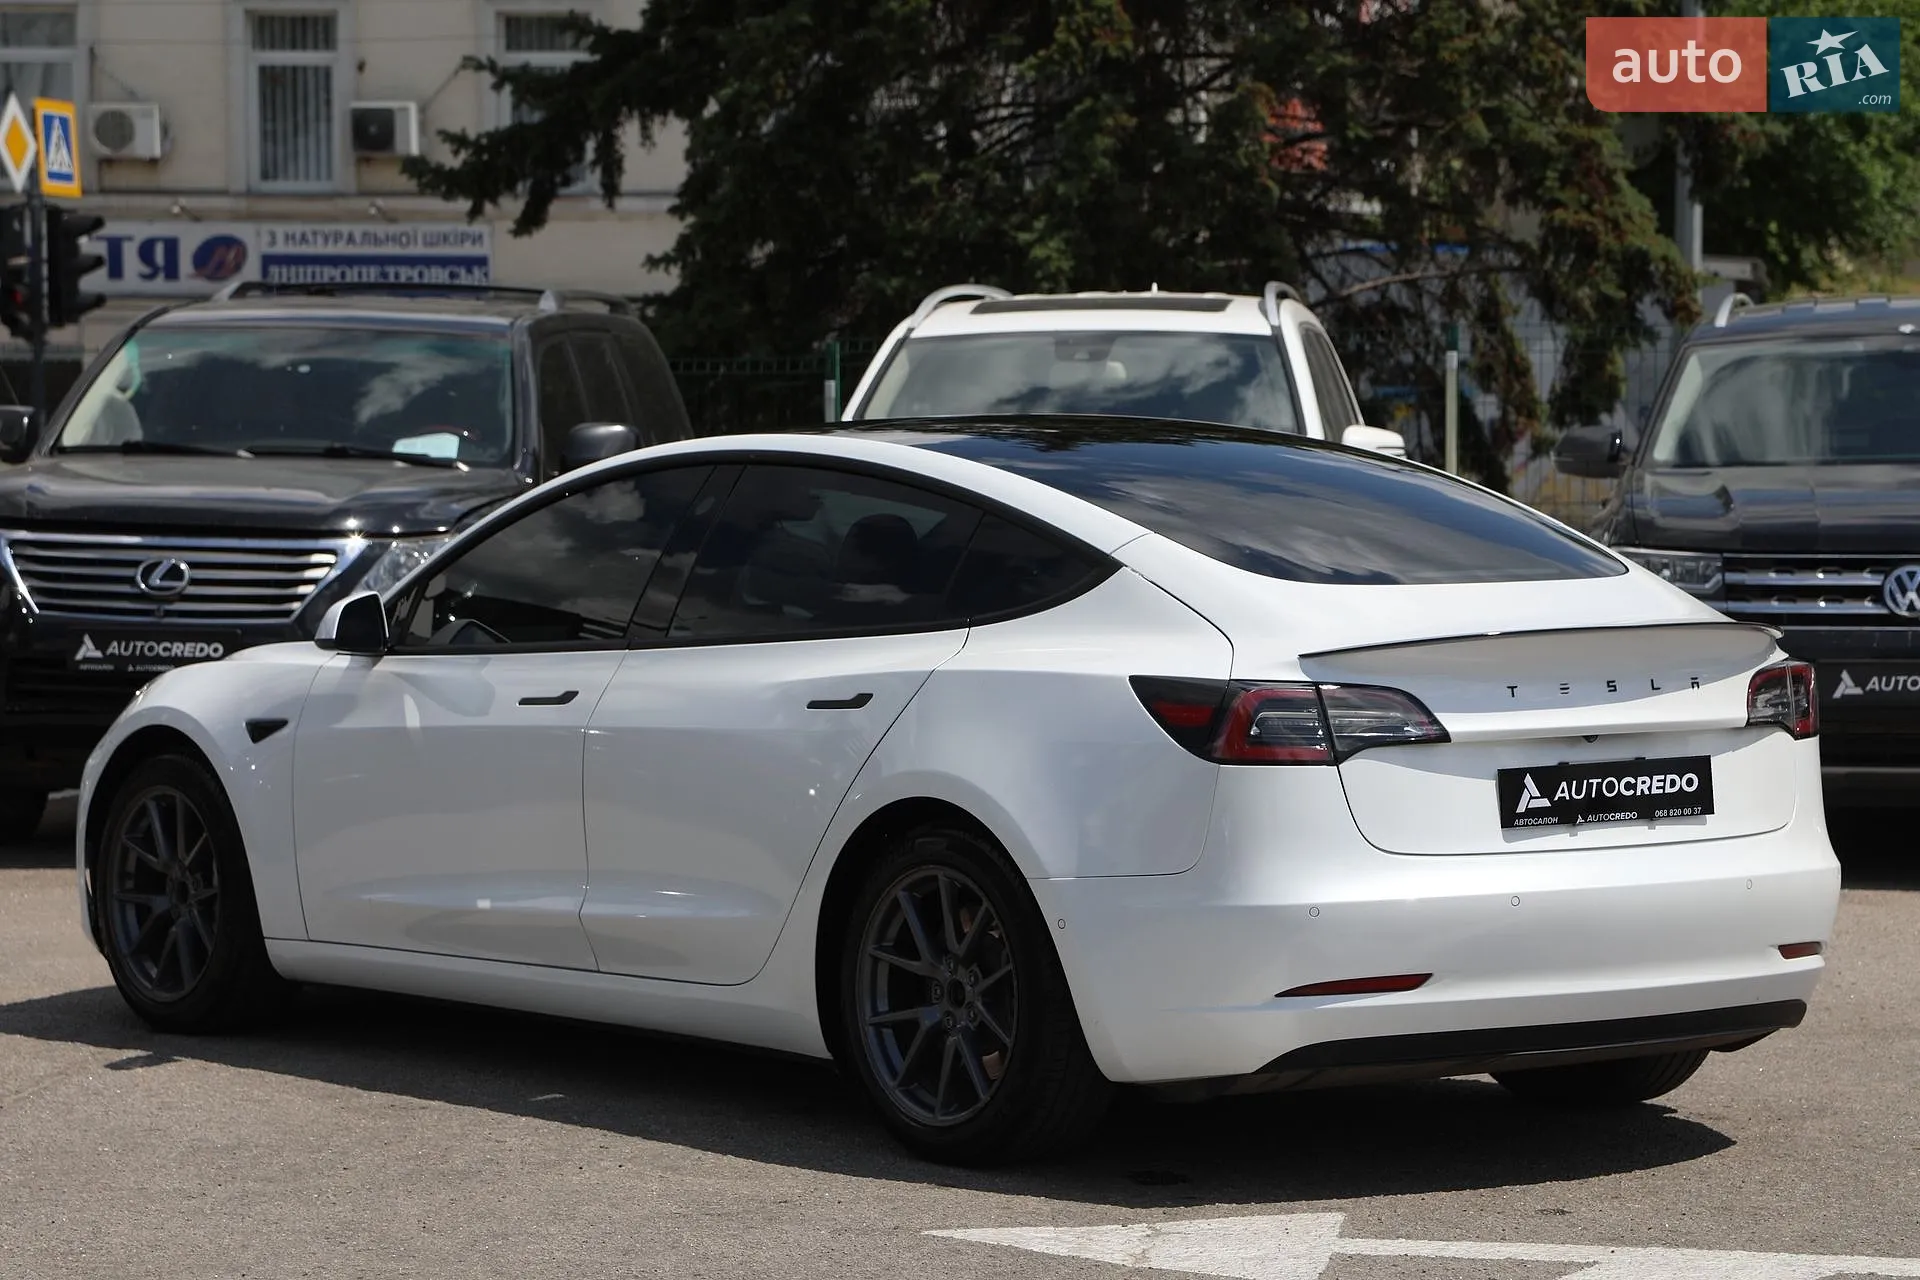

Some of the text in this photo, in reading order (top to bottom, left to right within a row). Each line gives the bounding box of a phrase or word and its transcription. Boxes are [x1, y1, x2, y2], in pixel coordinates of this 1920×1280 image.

[283, 227, 418, 249] НАТУРАЛЬНОЇ
[422, 226, 484, 248] ШКІРИ
[92, 234, 179, 281] ТЯ
[106, 640, 224, 658] AUTOCREDO
[1506, 676, 1700, 698] TESLA
[1553, 772, 1699, 802] AUTOCREDO
[1513, 816, 1558, 826] АВТОСАЛОН
[1586, 811, 1638, 822] AUTOCREDO
[1654, 807, 1702, 818] 068 820 00 37
